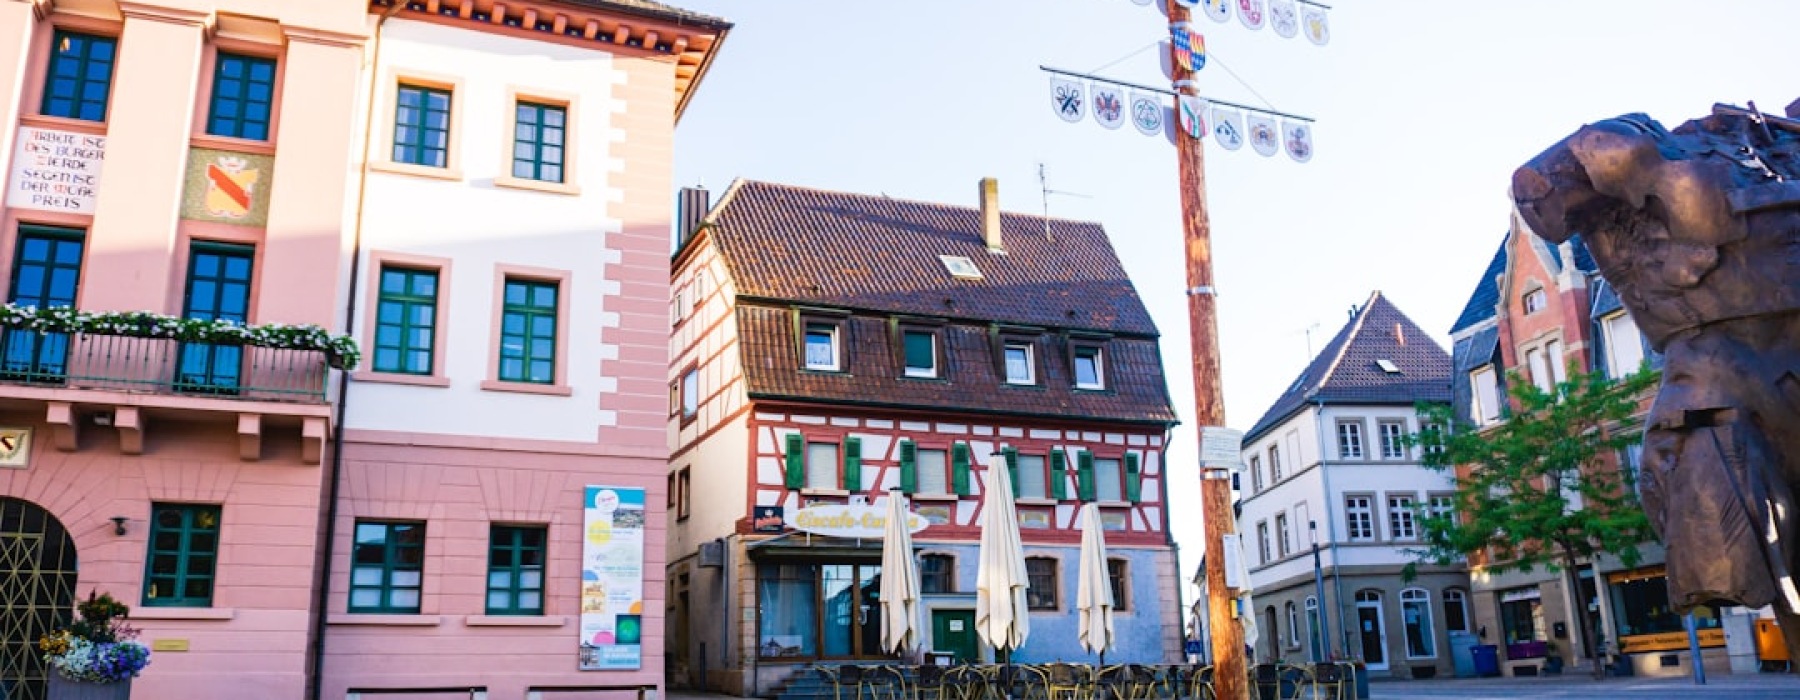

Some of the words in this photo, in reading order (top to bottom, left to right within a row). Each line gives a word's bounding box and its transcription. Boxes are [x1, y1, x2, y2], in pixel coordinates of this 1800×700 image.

[25, 142, 50, 154] DES
[36, 154, 87, 170] ZIERDE
[21, 181, 49, 192] DER
[32, 194, 81, 209] PREIS
